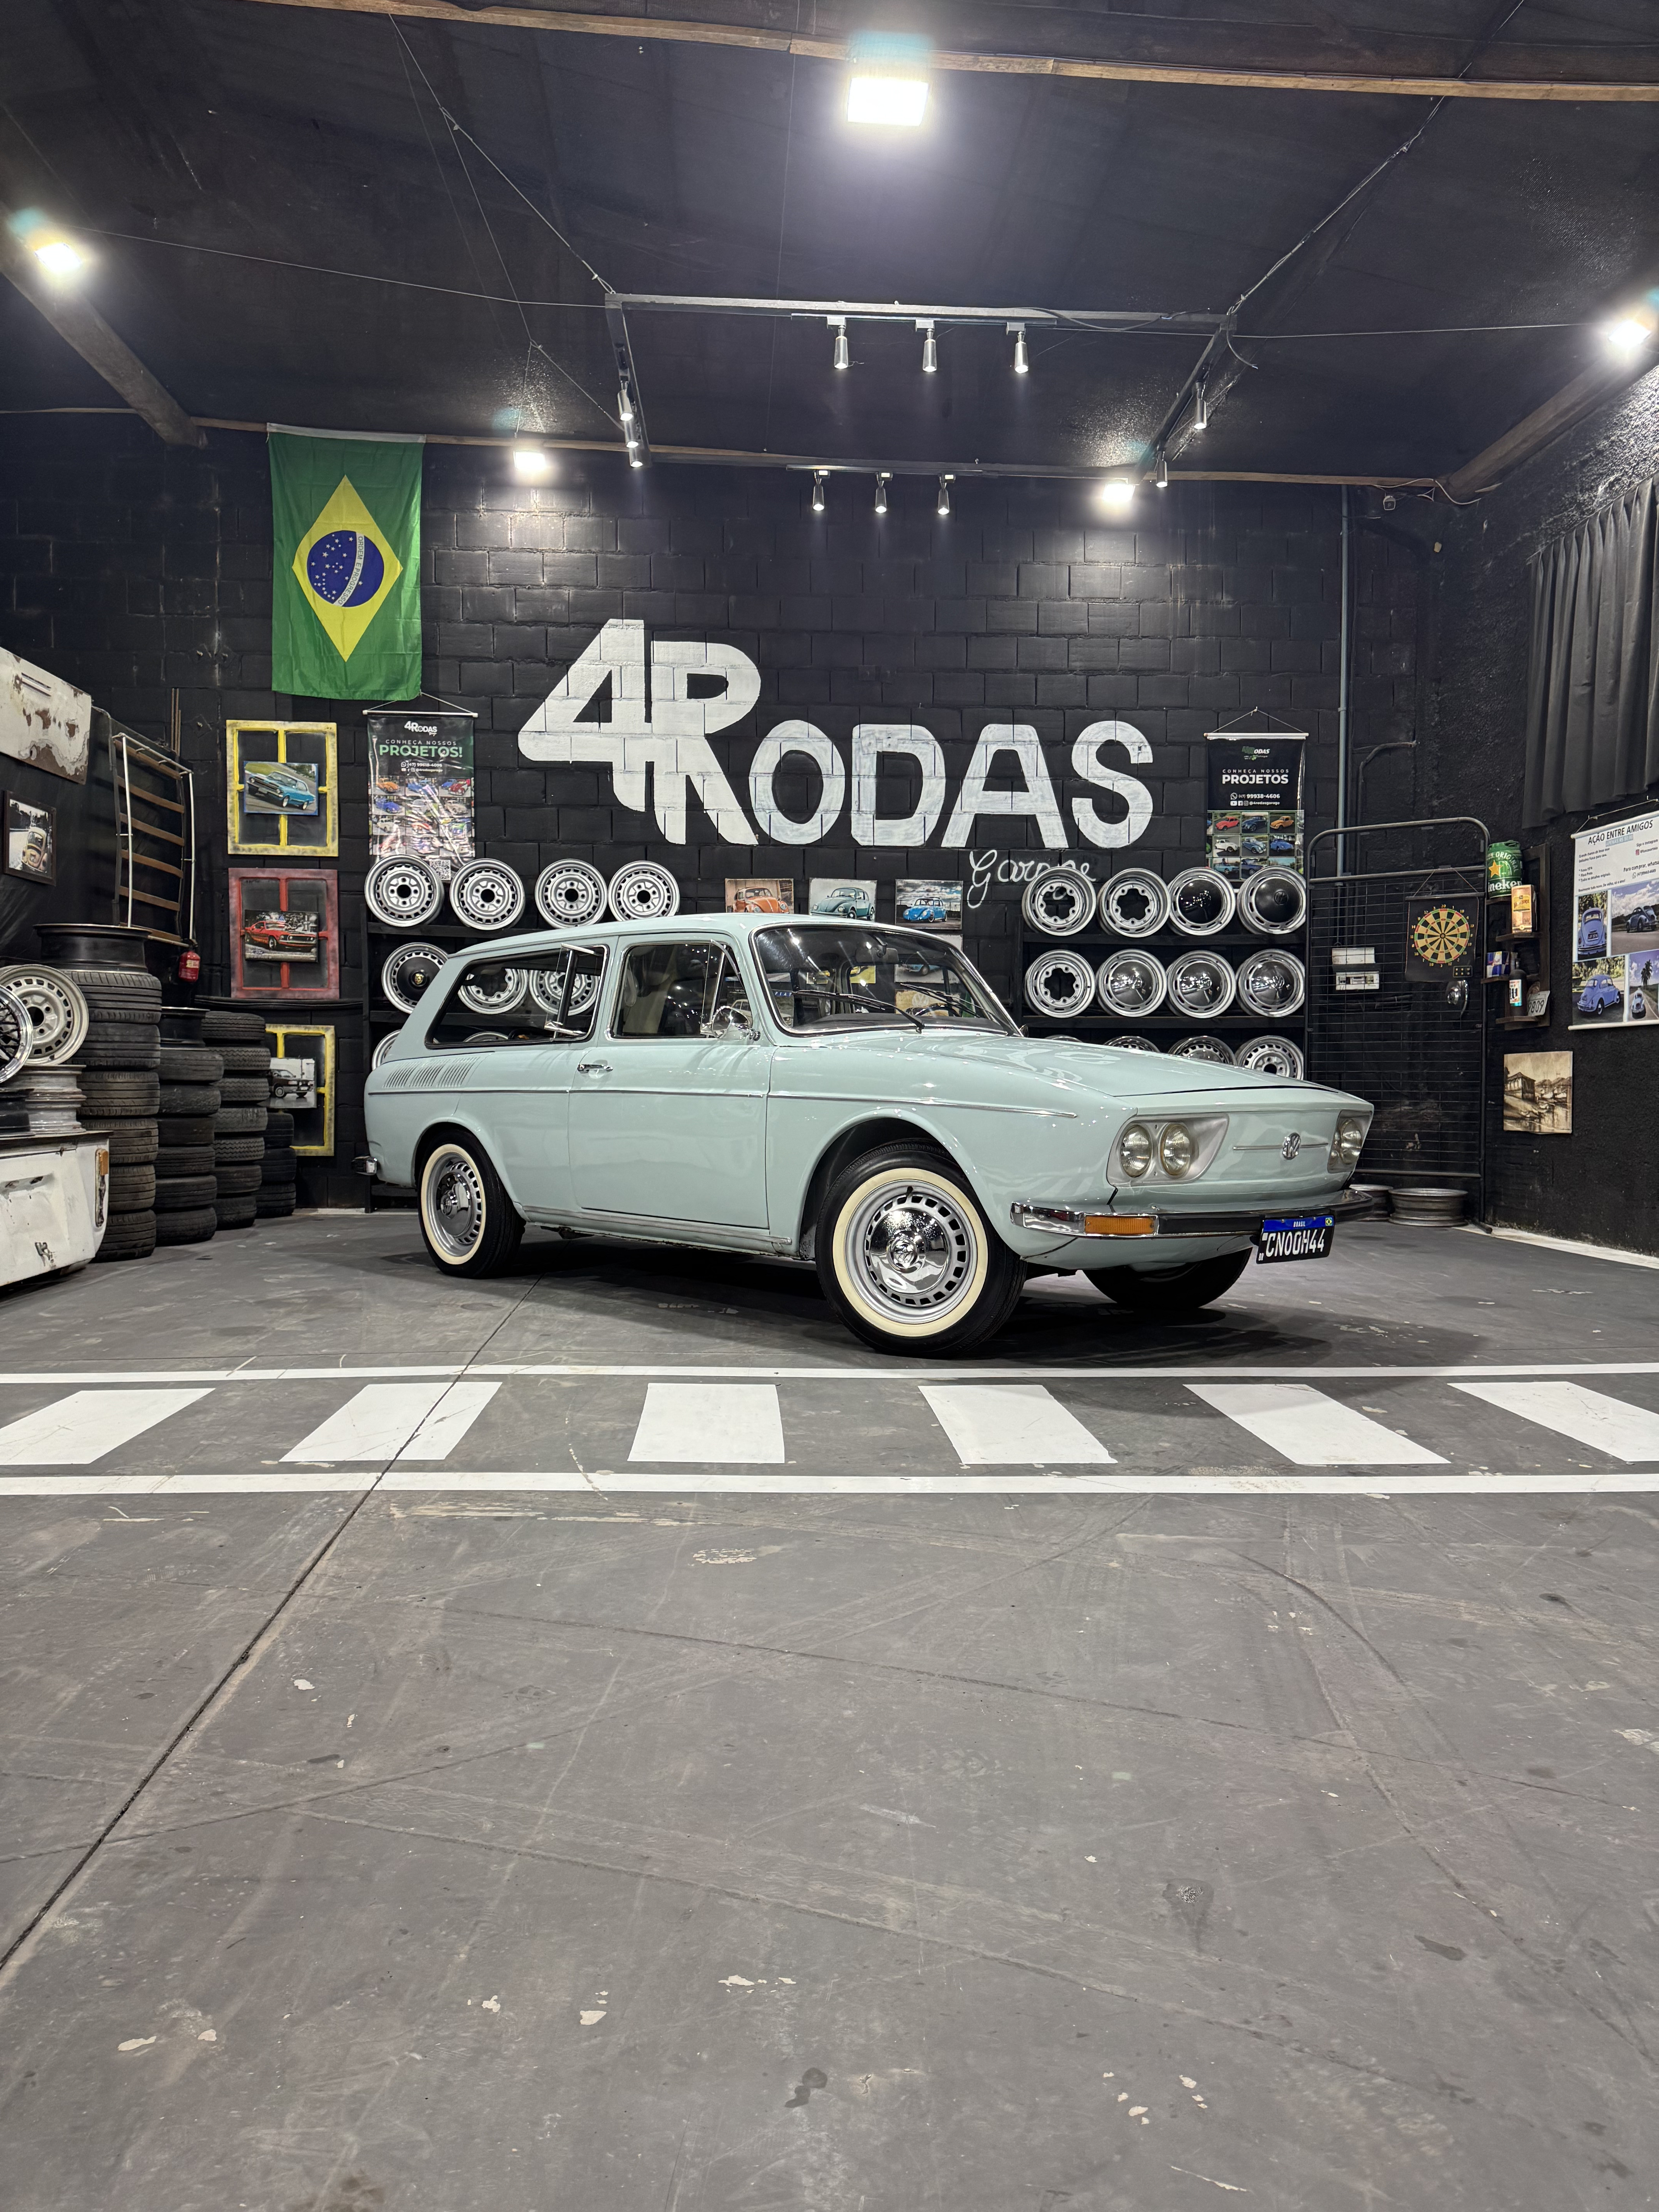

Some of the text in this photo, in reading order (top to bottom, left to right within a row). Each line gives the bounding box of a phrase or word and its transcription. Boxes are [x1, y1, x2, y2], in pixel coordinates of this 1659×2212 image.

[338, 568, 360, 605] PROGRESSO
[517, 618, 1153, 848] 4RODAS
[380, 744, 462, 757] PROJETOS!
[1222, 774, 1288, 784] PROJETOS
[1588, 820, 1653, 845] AÇÃO ENTRE AMIGOS
[1495, 851, 1519, 872] ORIGINAL
